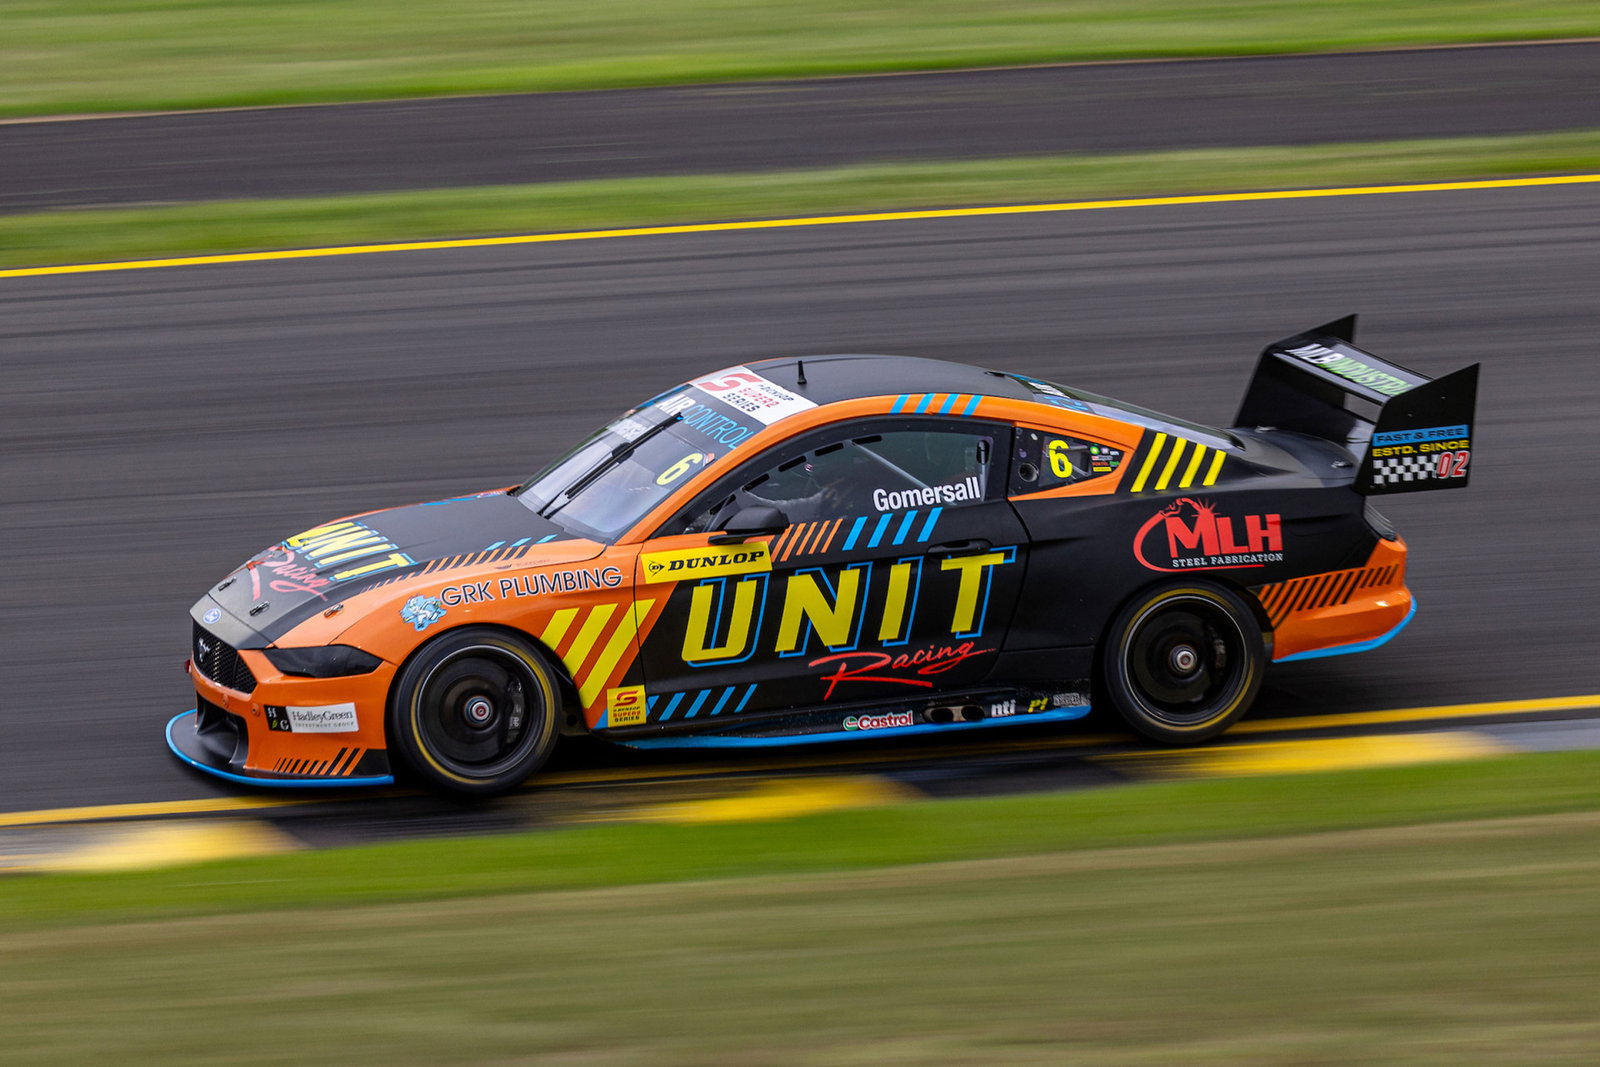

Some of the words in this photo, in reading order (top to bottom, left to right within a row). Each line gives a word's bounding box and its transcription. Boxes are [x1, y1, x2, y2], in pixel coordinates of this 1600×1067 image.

[723, 392, 761, 412] SERIES
[682, 404, 756, 449] CONTROL
[1376, 431, 1412, 443] FAST
[1414, 430, 1425, 441] &
[1427, 427, 1466, 439] FREE
[1049, 439, 1074, 479] 6
[1372, 445, 1416, 457] ESTD.
[1419, 439, 1470, 453] SINCE
[1434, 450, 1470, 479] 02
[656, 453, 704, 486] 6
[872, 476, 981, 513] Gomersall
[283, 520, 417, 583] UNIT
[1165, 511, 1284, 559] MLH
[247, 546, 330, 602] Racing
[667, 549, 765, 572] DUNLOP
[1172, 557, 1208, 568] STEEL
[1211, 553, 1284, 566] FABRICATION
[440, 580, 494, 607] GRK
[499, 566, 623, 599] PLUMBING
[681, 546, 1017, 668] UNIT
[808, 639, 997, 701] Racing
[291, 710, 354, 724] HadleyGreen
[857, 712, 914, 729] Castrol
